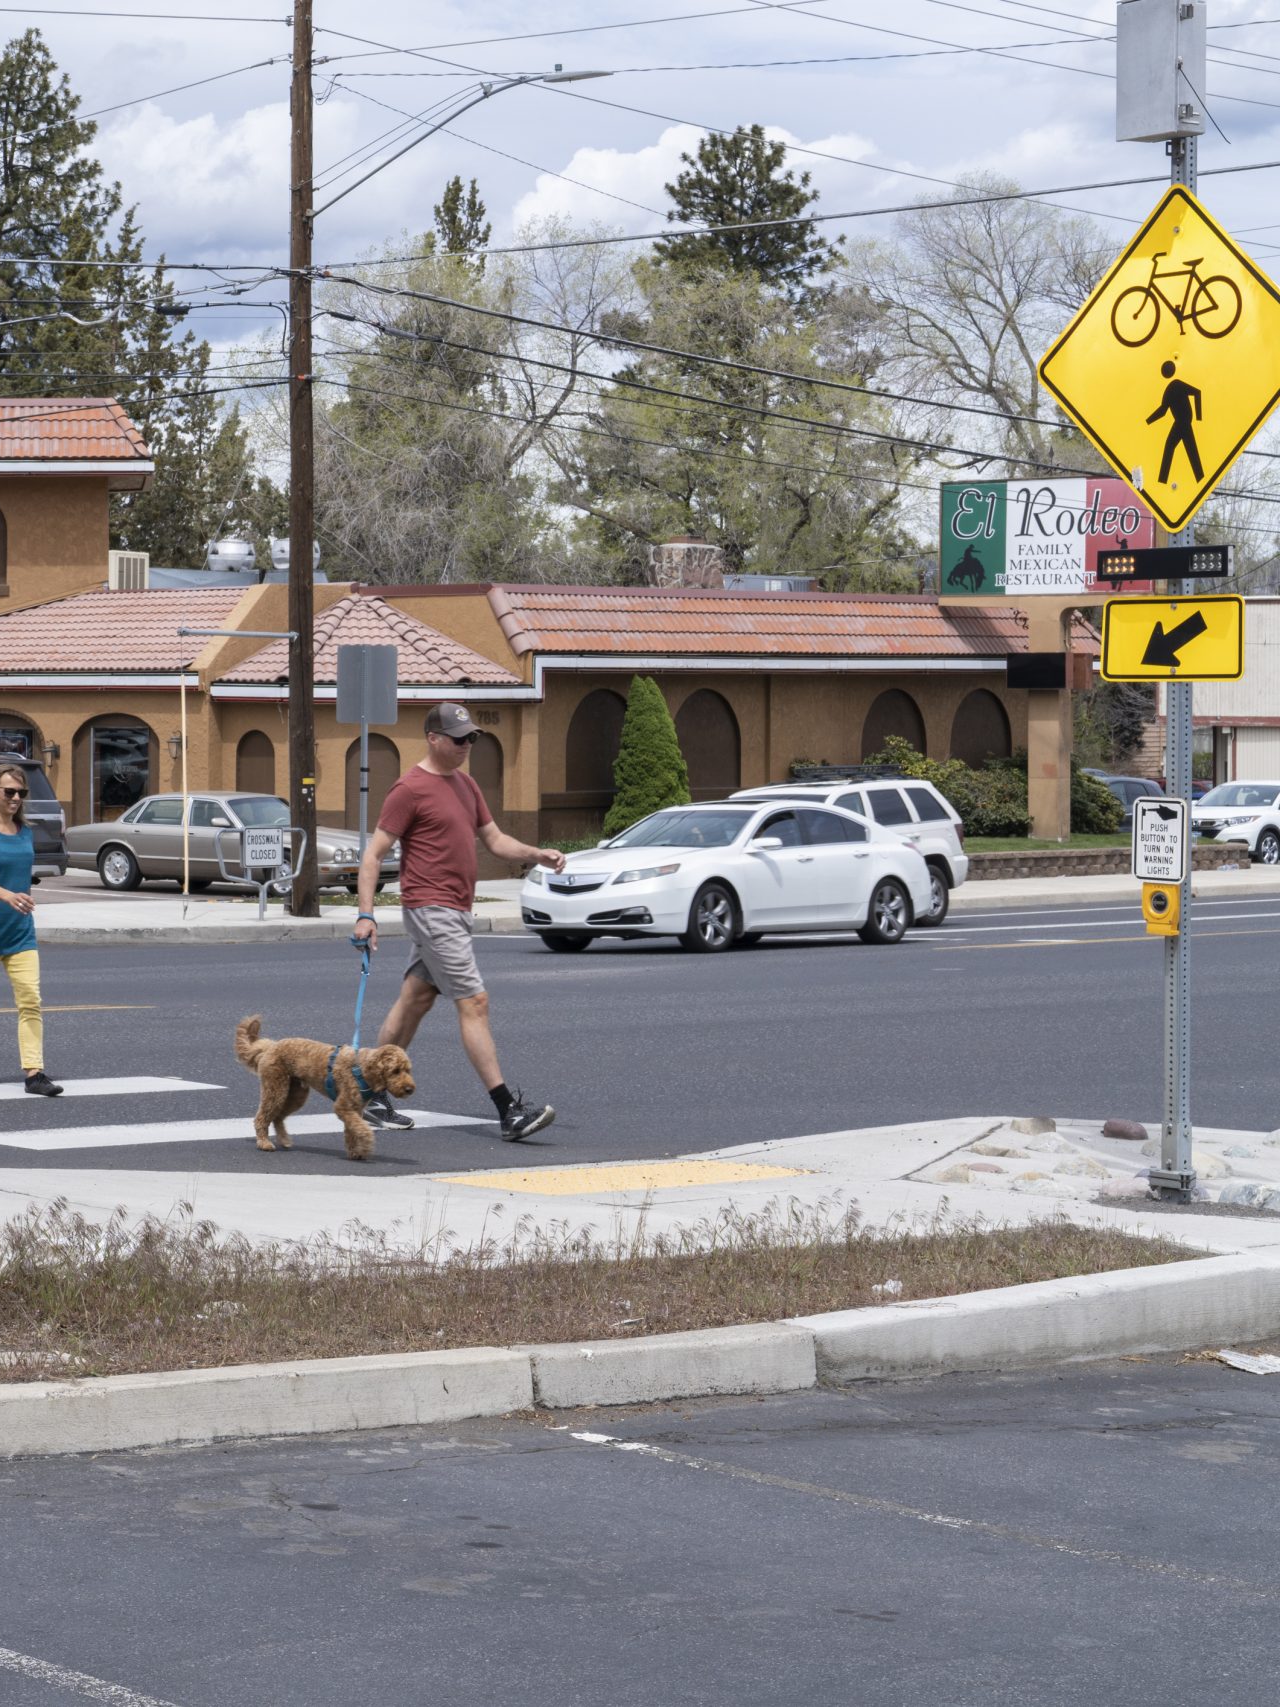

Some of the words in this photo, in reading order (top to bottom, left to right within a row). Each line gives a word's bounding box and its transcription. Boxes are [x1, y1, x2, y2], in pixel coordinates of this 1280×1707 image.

[951, 488, 997, 539] El
[1014, 486, 1141, 537] Rodeo
[1017, 543, 1073, 556] FAMILY
[1009, 558, 1082, 571] MEXICAN
[995, 571, 1096, 587] RESTAURANT
[1150, 823, 1168, 832] PUSH
[247, 834, 280, 845] CROSSWALK
[1140, 833, 1166, 843] BUTTON
[1170, 835, 1178, 844] TO
[251, 849, 276, 860] CLOSED
[1143, 844, 1161, 853] TURN
[1164, 845, 1174, 854] ON
[1144, 855, 1174, 865] WARNING
[1147, 866, 1170, 875] LIGHTS
